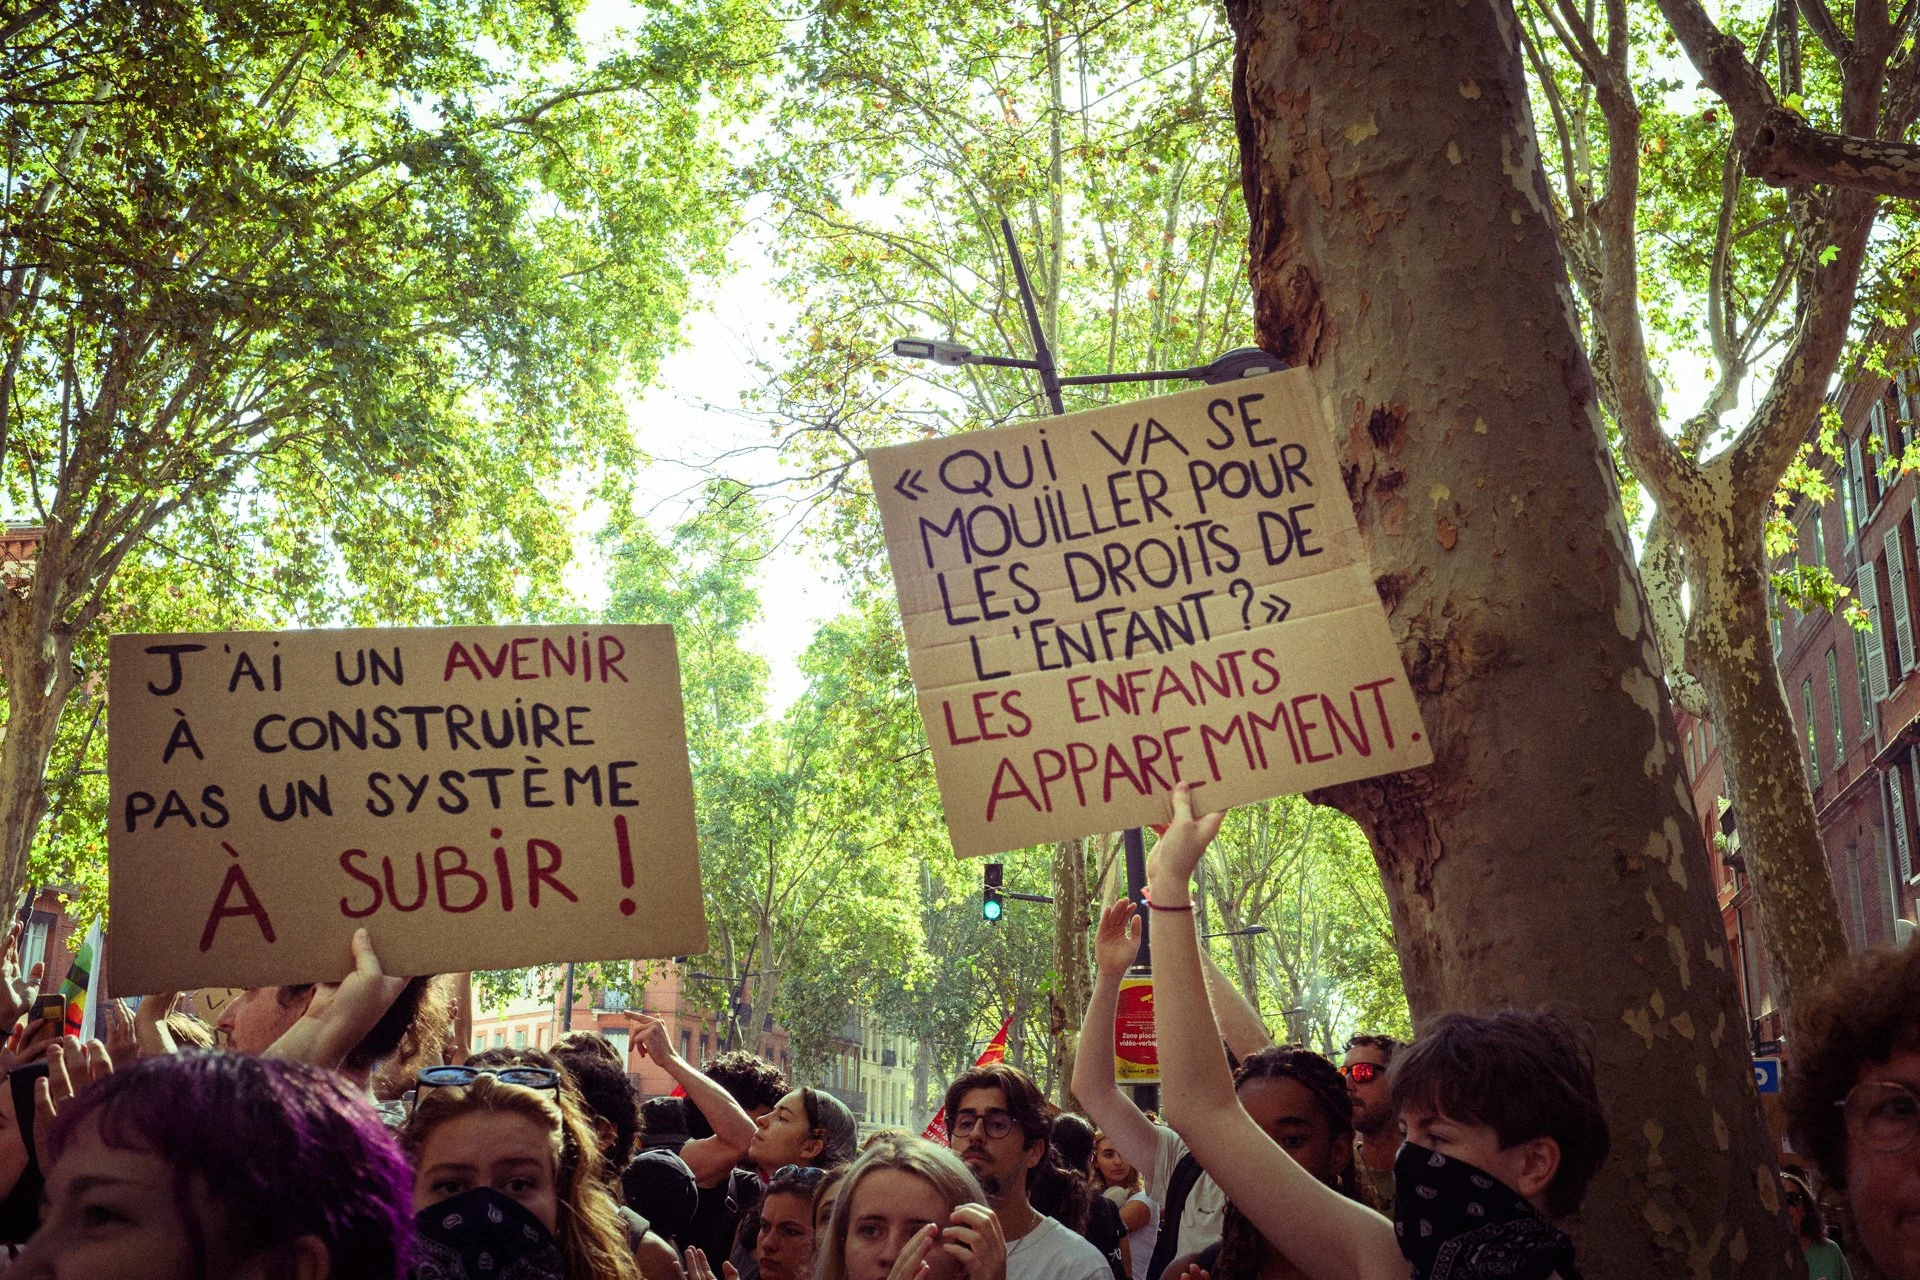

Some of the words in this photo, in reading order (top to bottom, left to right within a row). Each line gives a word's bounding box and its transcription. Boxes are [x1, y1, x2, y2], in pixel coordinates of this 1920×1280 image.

[1090, 417, 1190, 467] VA
[1206, 393, 1278, 451] SE
[1188, 442, 1314, 515] POUR
[937, 560, 1041, 626] LES
[1256, 503, 1324, 567] DE
[334, 645, 404, 688] UN
[942, 690, 1033, 747] LES
[1065, 647, 1282, 725] ENFANTS
[161, 708, 205, 765] À
[985, 676, 1423, 823] APPAREMMENT.
[122, 780, 231, 835] PAS
[258, 773, 334, 823] UN
[364, 755, 641, 819] SYSTÈME
[198, 840, 278, 953] À
[612, 813, 638, 917] !
